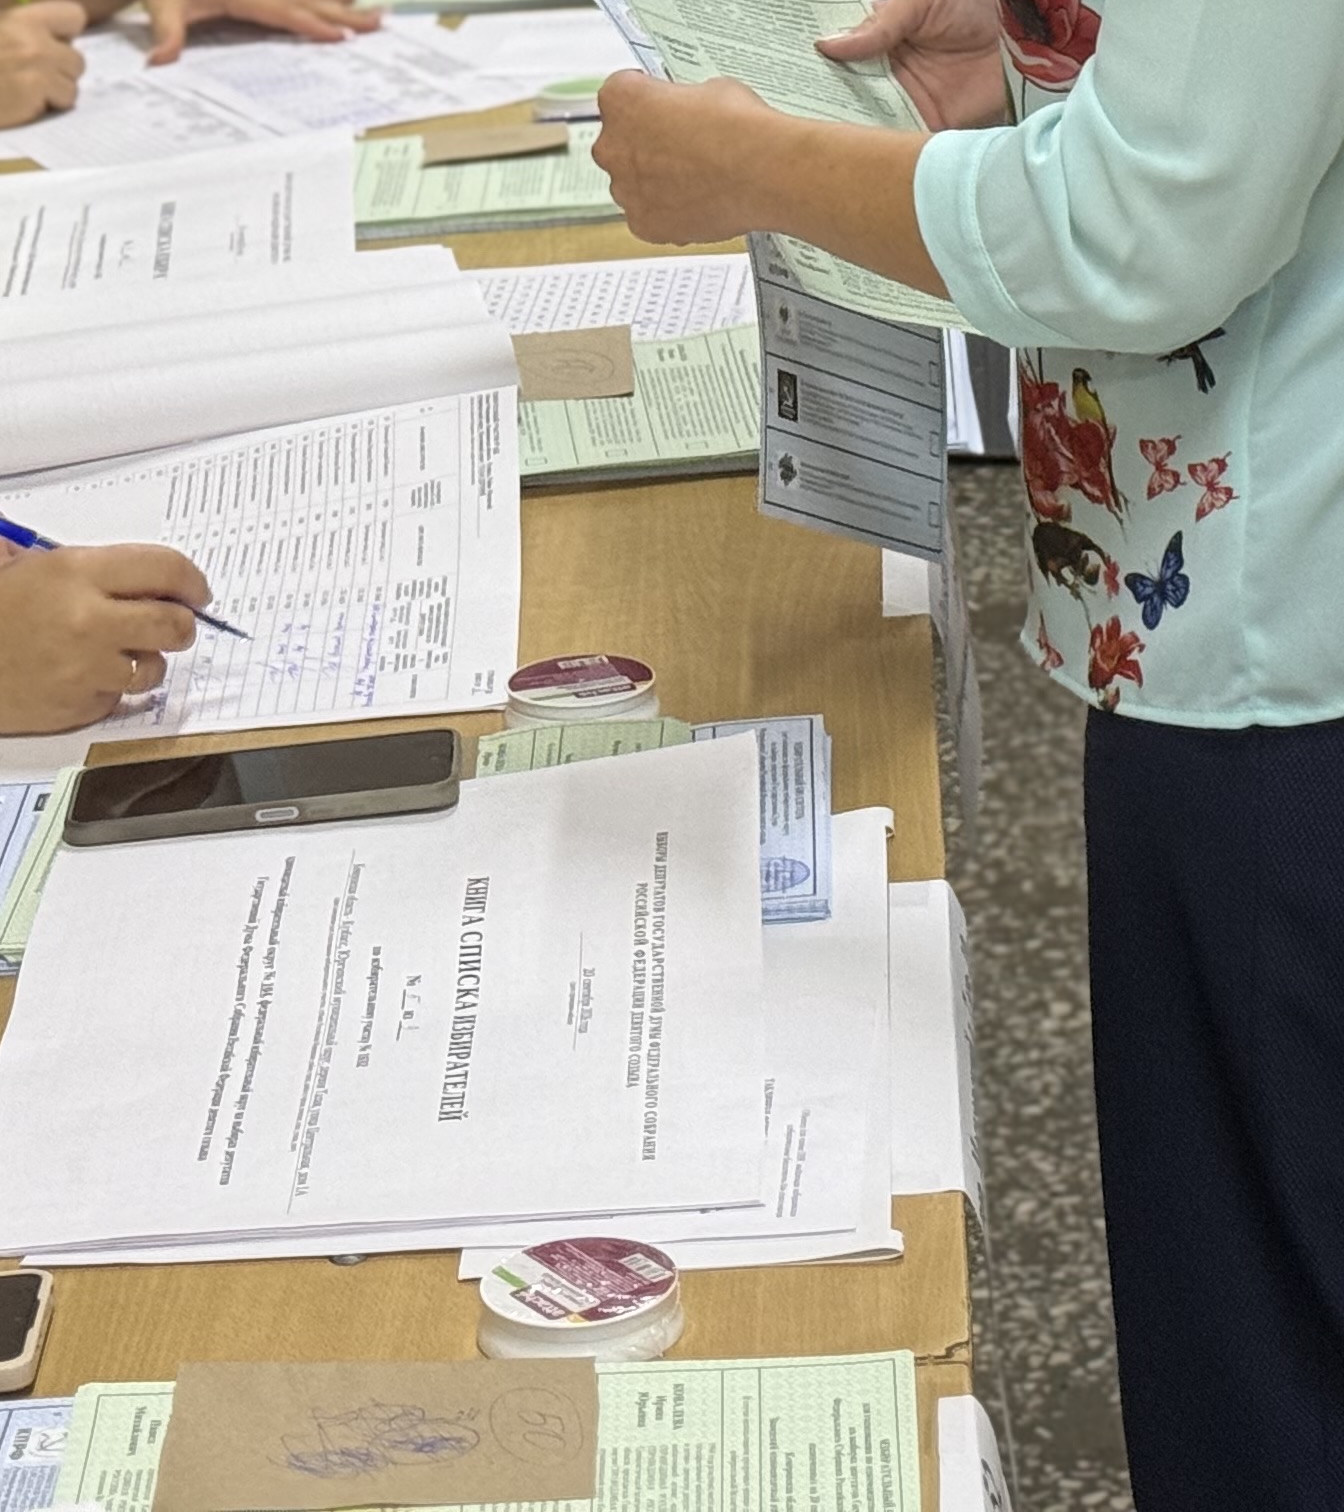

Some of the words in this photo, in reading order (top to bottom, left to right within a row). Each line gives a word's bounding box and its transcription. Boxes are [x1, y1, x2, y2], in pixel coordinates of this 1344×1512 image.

[462, 876, 491, 927] КНИГА
[633, 882, 649, 946] РОССИЙСКОЙ
[653, 864, 667, 913] ДЕПУТАТОВ
[454, 931, 485, 1011] СПИСКА
[631, 949, 646, 1009] ФЕДЕРАЦИИ
[650, 915, 666, 1013] ГОСУДАРСТВЕННОЙ
[629, 1011, 644, 1052] ДЕВЯТОГО
[648, 1014, 663, 1040] ДУМЫ
[438, 1014, 478, 1123] ИЗБИРАТЕЛЕЙ
[645, 1041, 661, 1109] ФЕДЕРАЛЬНОГО
[641, 1110, 658, 1162] СОБРАНИЯ
[672, 1383, 685, 1431] КОВАЛЕВА
[8, 1427, 33, 1461] КПРФ
